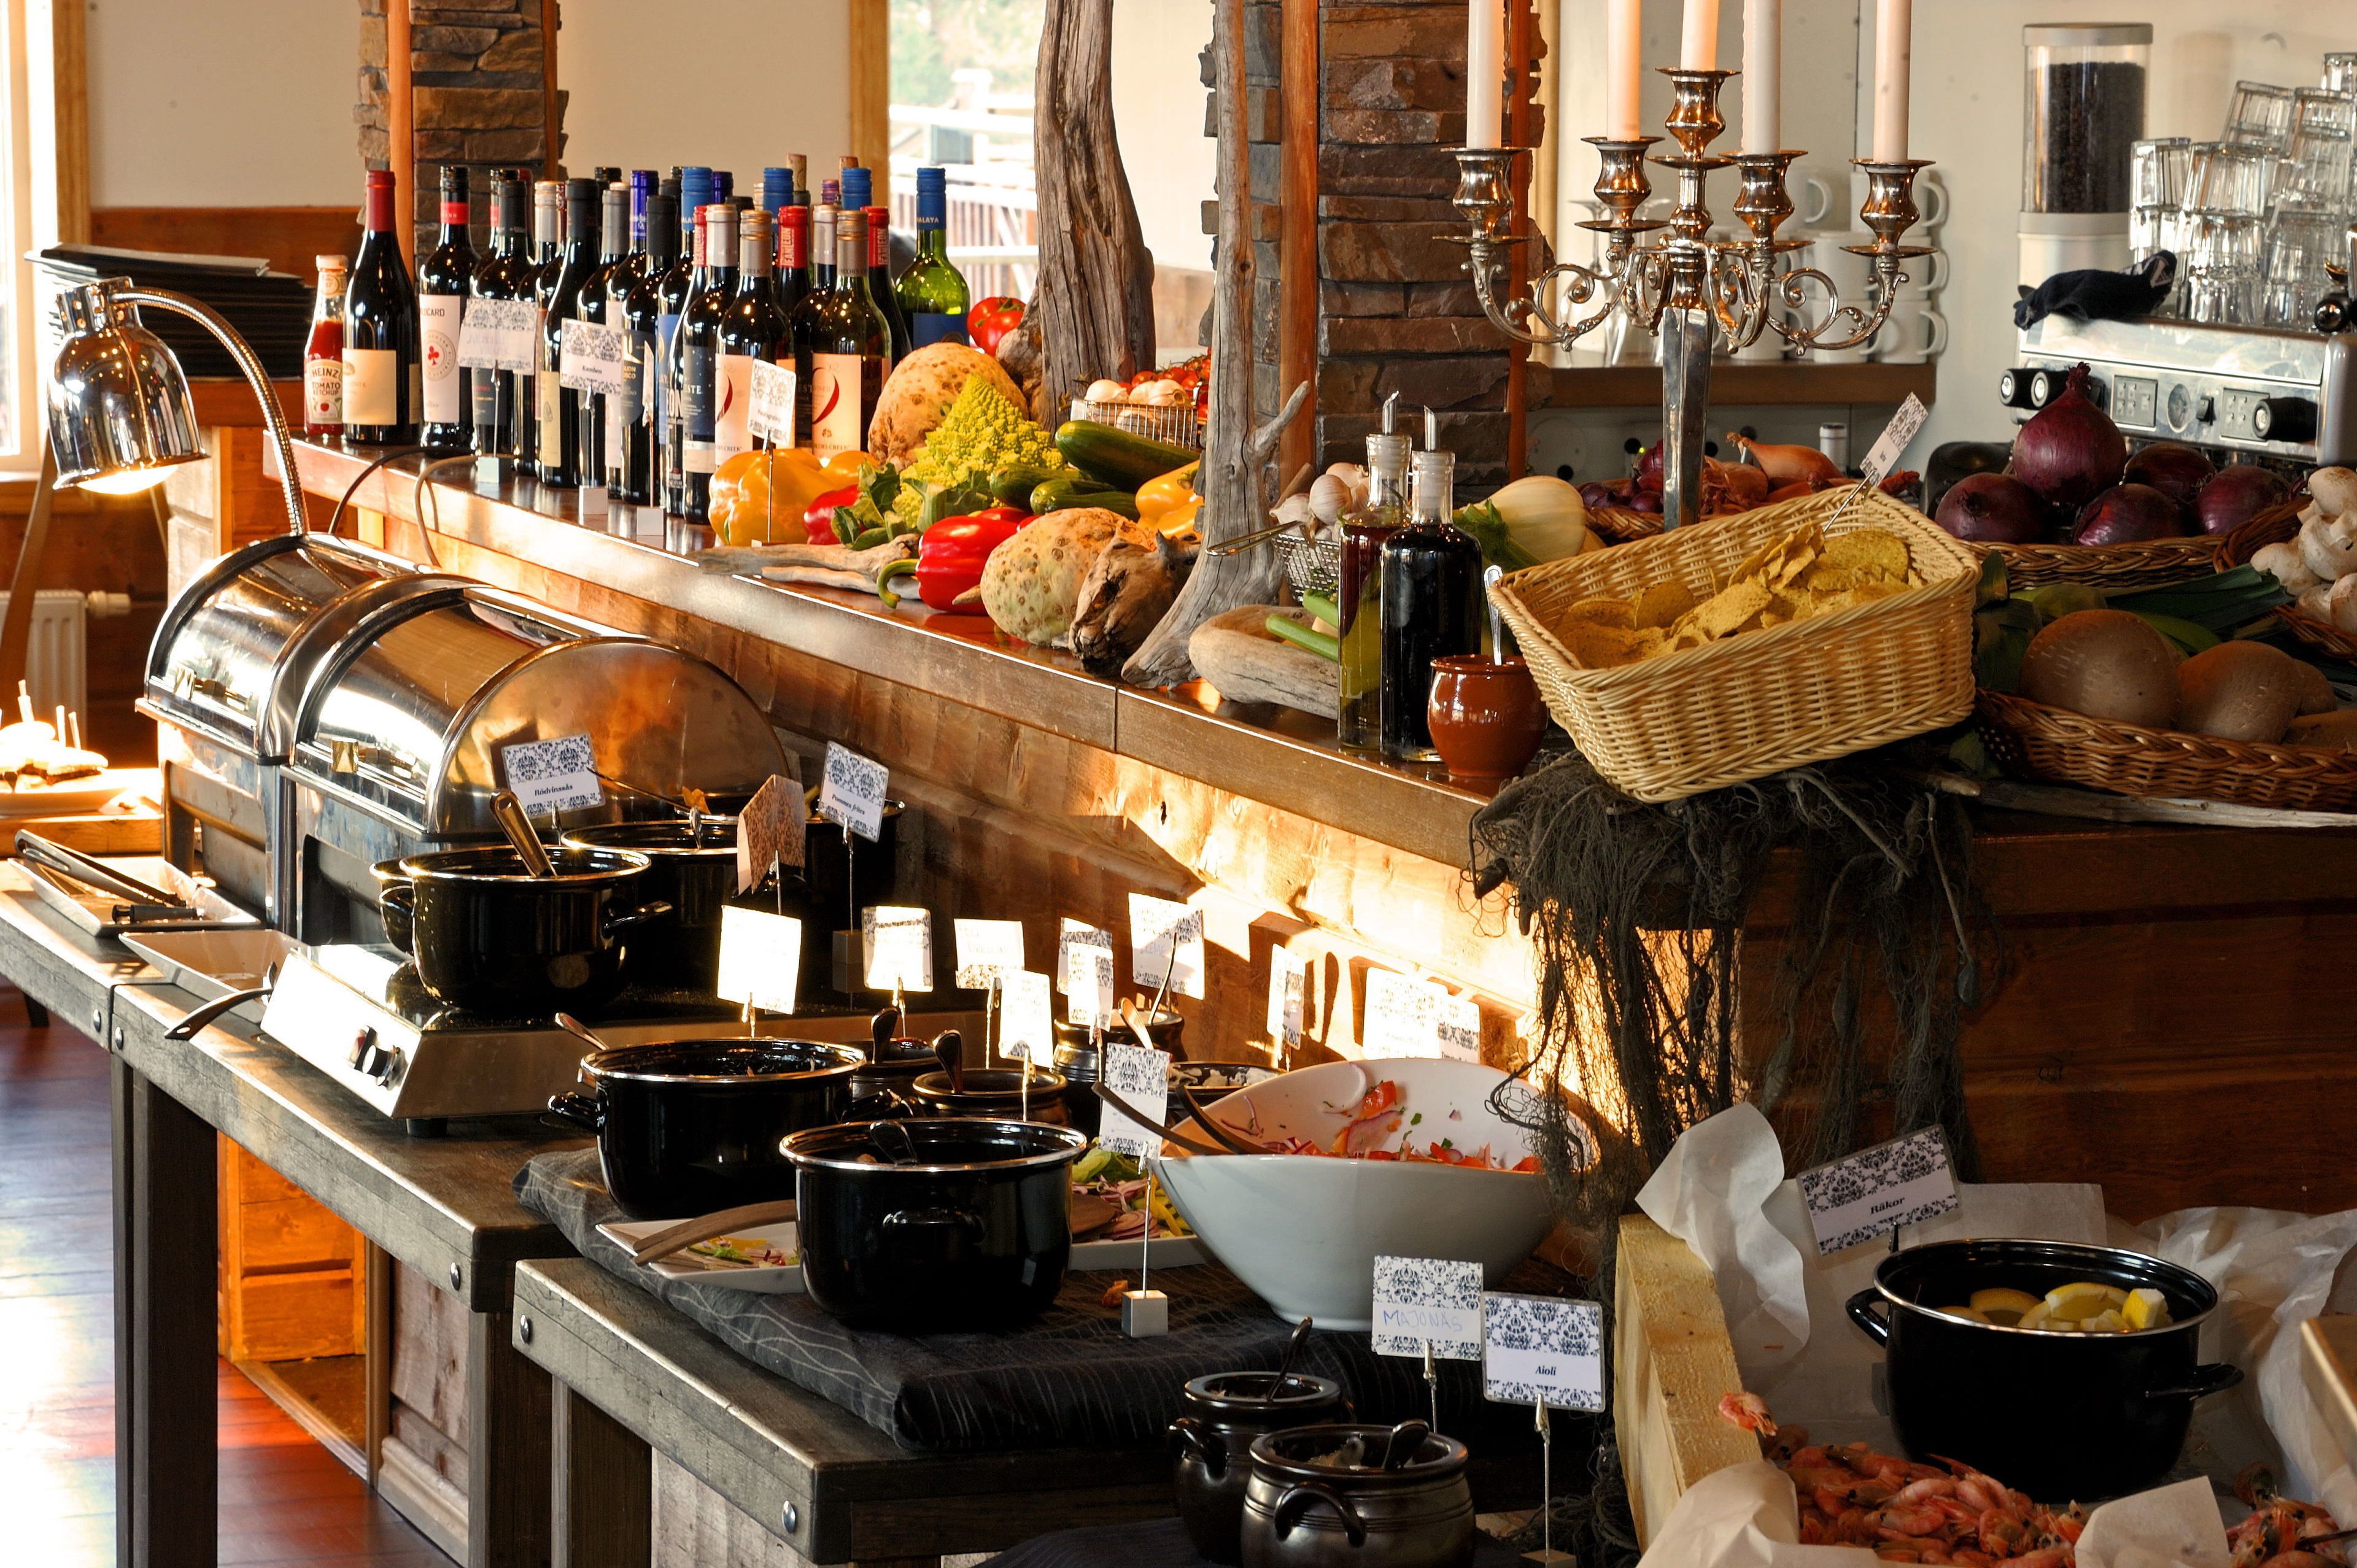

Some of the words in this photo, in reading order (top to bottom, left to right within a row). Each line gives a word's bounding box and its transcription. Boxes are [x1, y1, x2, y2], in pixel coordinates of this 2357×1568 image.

[312, 368, 339, 379] HEINZ
[535, 784, 573, 796] Rödvinssås
[1871, 1197, 1905, 1215] Räkor
[1383, 1309, 1463, 1332] MAJONÄS
[1535, 1365, 1557, 1376] Aioli
